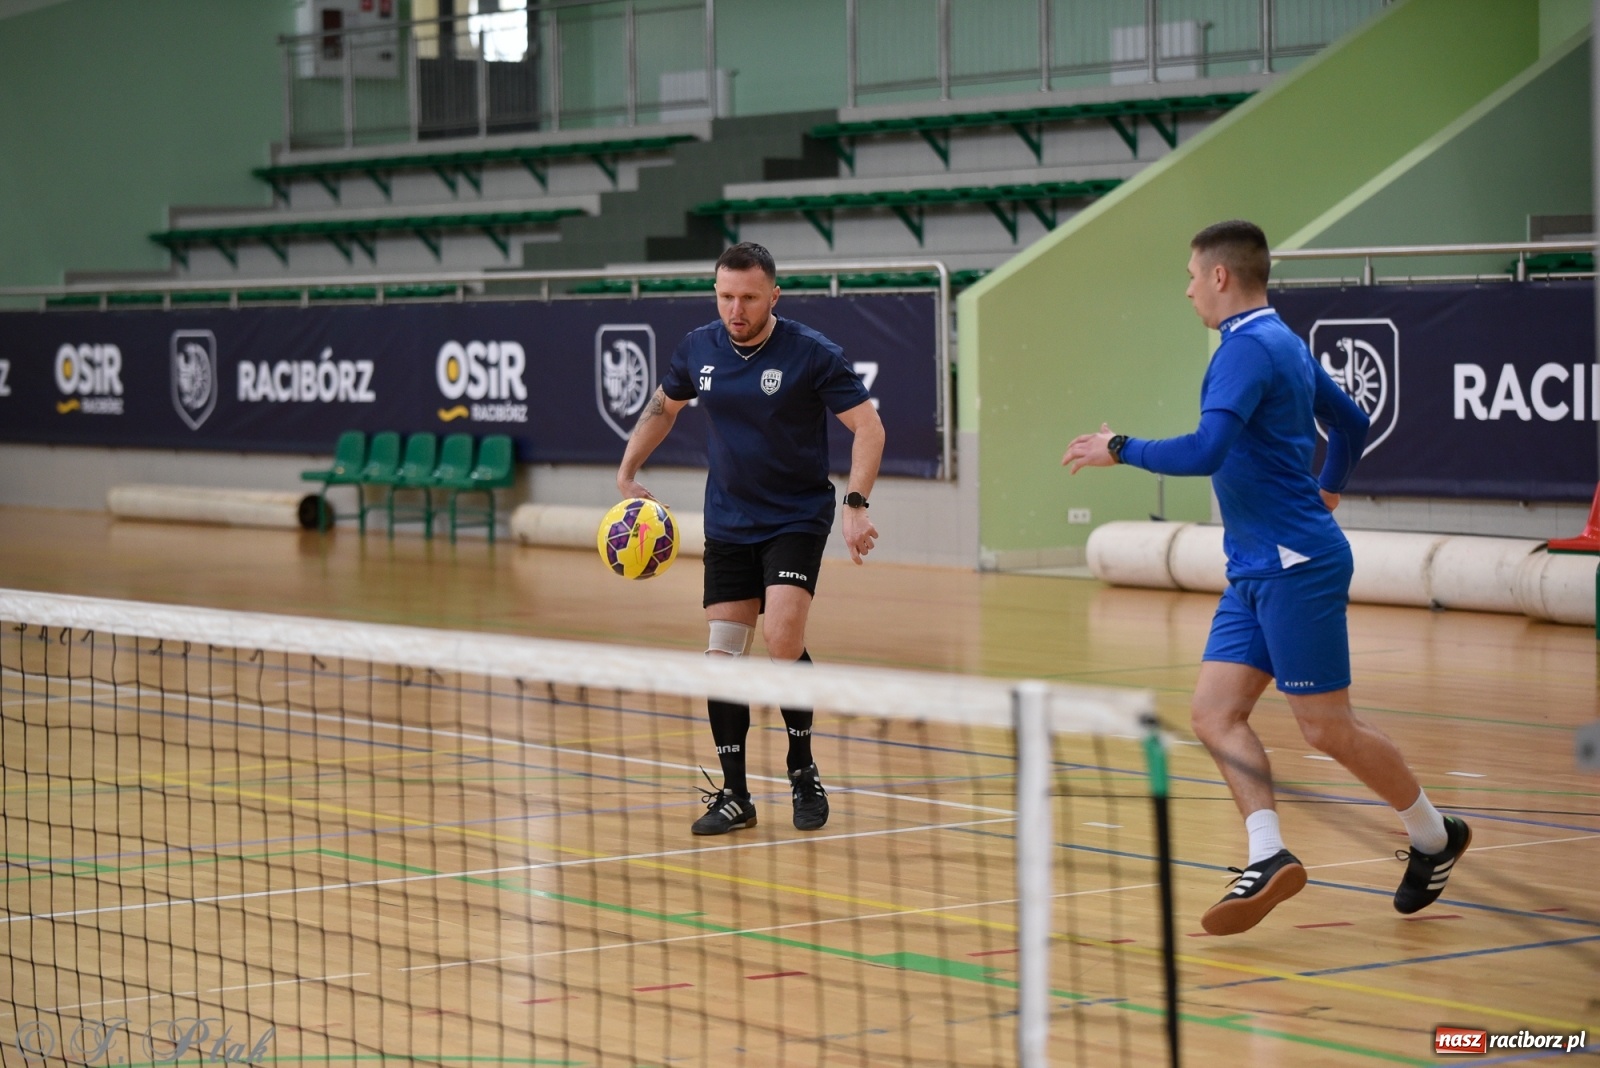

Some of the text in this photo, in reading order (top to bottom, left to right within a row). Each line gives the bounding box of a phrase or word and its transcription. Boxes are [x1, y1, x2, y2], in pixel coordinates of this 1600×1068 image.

[237, 346, 376, 402] RACIBÓRZ
[436, 341, 528, 401] OSiR
[699, 376, 712, 391] SM
[789, 727, 812, 737] zin
